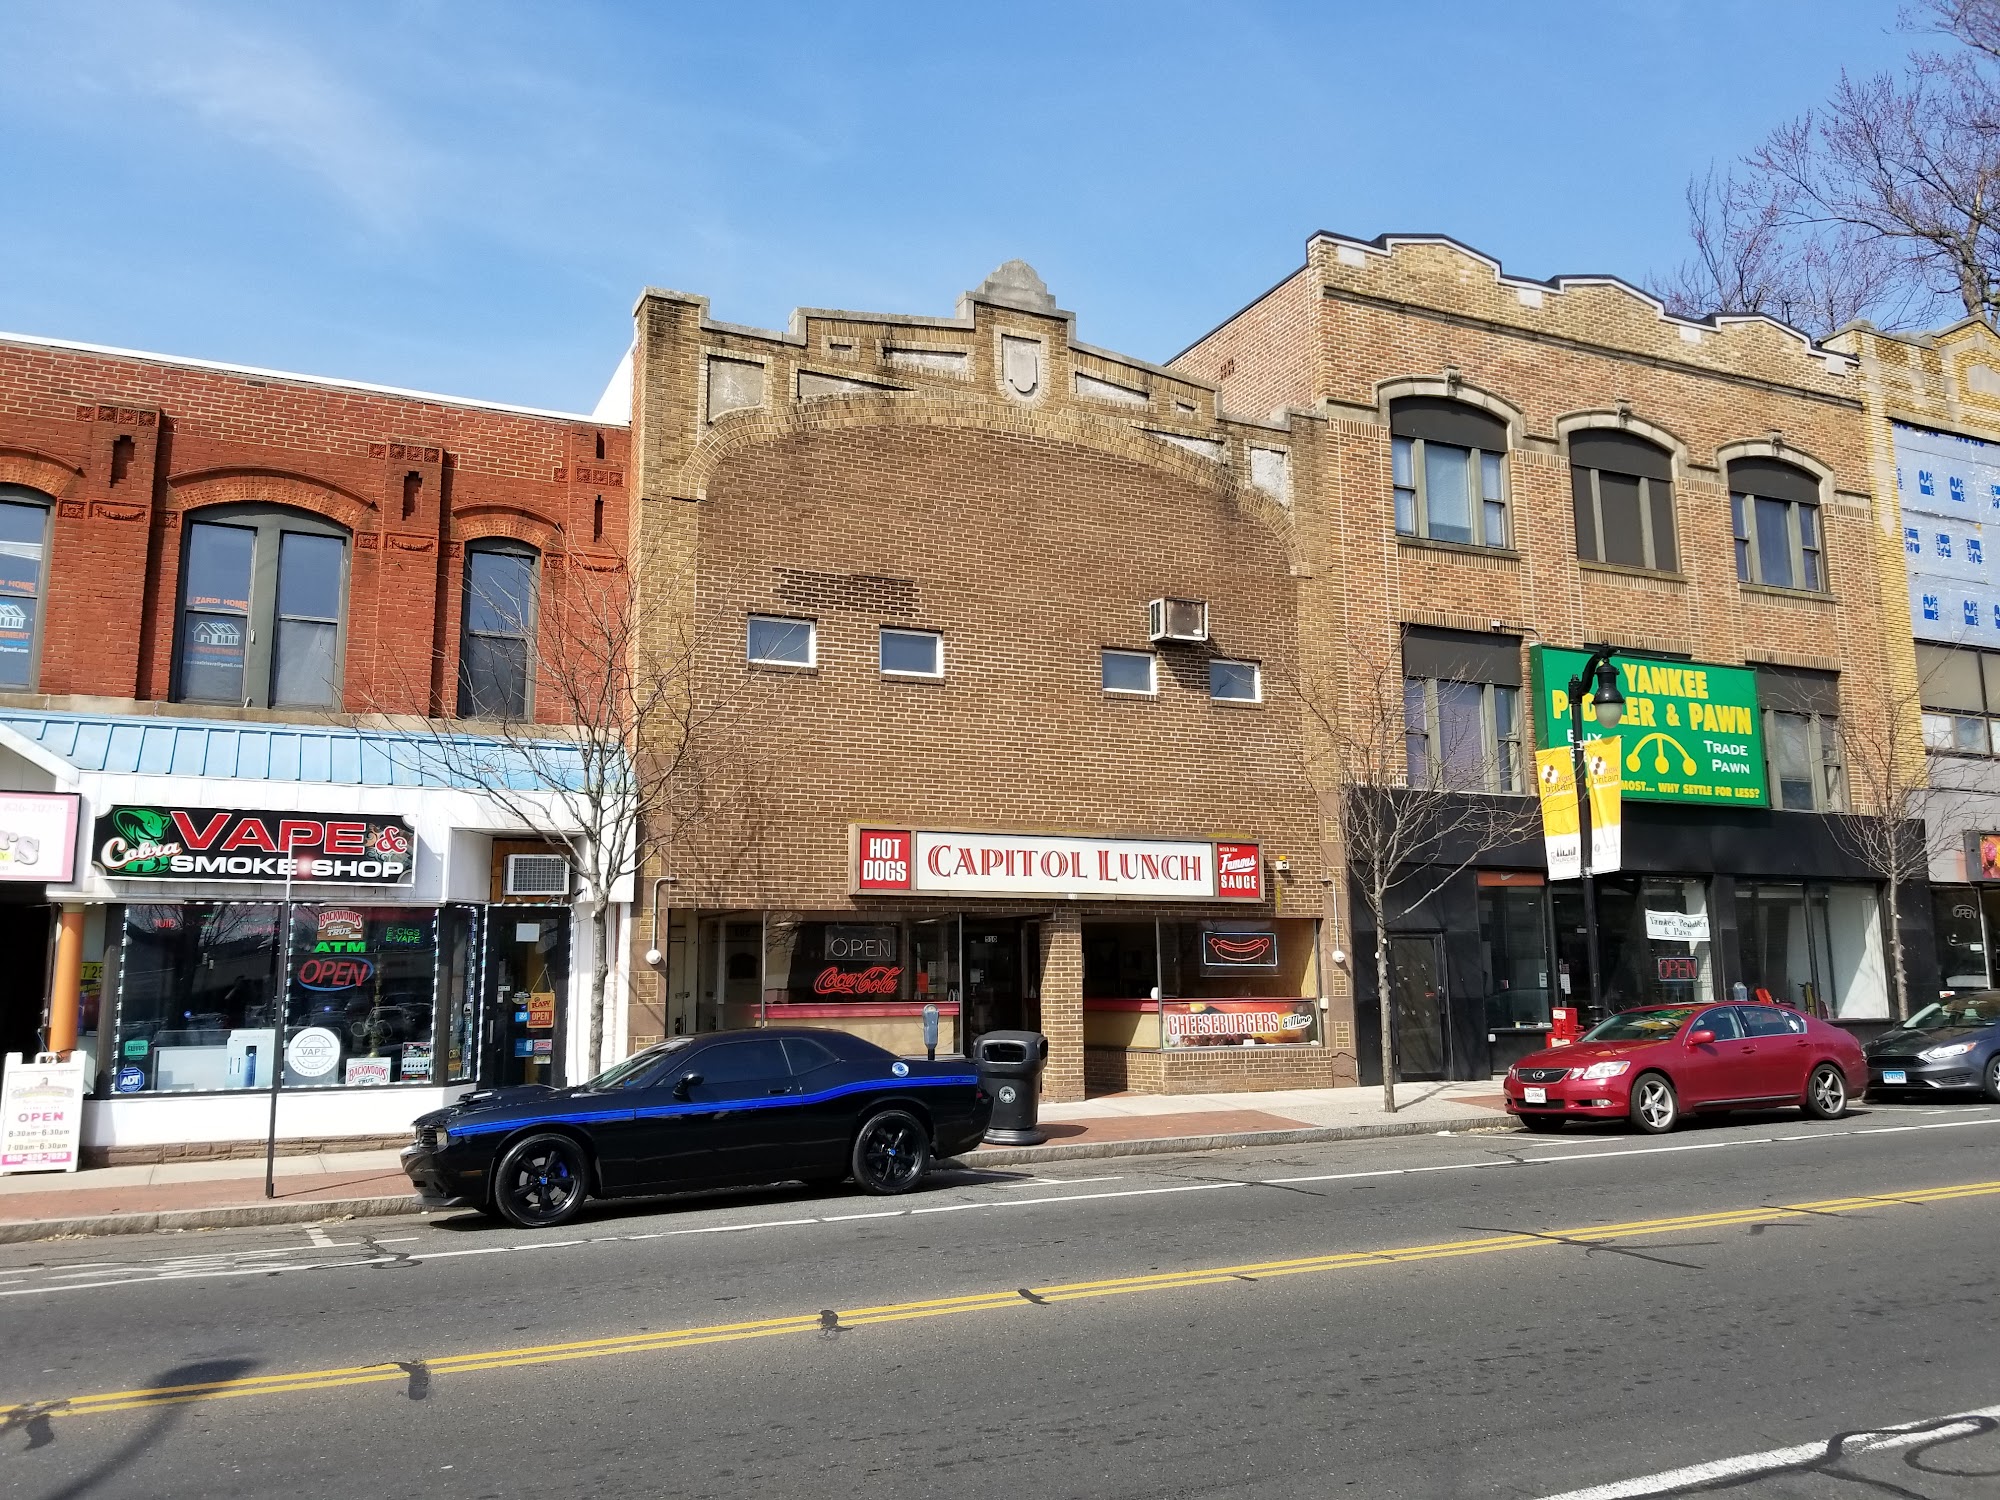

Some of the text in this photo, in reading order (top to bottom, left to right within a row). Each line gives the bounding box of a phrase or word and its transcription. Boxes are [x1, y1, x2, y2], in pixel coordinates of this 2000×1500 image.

[224, 599, 248, 611] HOME
[1622, 663, 1709, 699] YANKEE
[1666, 703, 1681, 726] &
[1688, 702, 1752, 735] PAWN
[1703, 740, 1748, 756] TRADE
[1712, 759, 1750, 774] PAWN
[1658, 782, 1680, 794] WHY
[1682, 784, 1712, 796] SETTLE
[1714, 786, 1732, 797] FOR
[1734, 788, 1760, 798] LESS?
[170, 811, 408, 855] VAPE &
[101, 837, 182, 869] Cobra
[869, 838, 902, 859] HOT
[170, 856, 404, 878] SMOKE SHOP
[863, 860, 906, 882] DOGS
[928, 844, 1202, 882] CAPITOL LUNCH
[1220, 853, 1256, 874] Famous
[1221, 874, 1256, 889] SAUCE
[318, 910, 362, 930] BACKWOODS
[1650, 916, 1676, 926] Yankee
[1954, 908, 1976, 919] OPEN
[327, 928, 352, 936] TRUE
[386, 926, 420, 936] E-CIGS
[386, 934, 420, 944] E-VAPE
[1674, 928, 1692, 936] Pawn
[314, 941, 366, 953] ATM
[830, 937, 891, 958] OPEN
[300, 960, 368, 986] OPEN
[1660, 960, 1696, 979] OPEN
[532, 1000, 550, 1008] RAW
[532, 1012, 550, 1020] OPEN
[1168, 1012, 1279, 1036] CHEESEBURGERS
[1288, 1014, 1312, 1028] More
[302, 1048, 328, 1056] VAPE
[122, 1075, 140, 1086] ADT
[348, 1064, 388, 1082] BACKWOODS
[18, 1112, 64, 1122] OPEN
